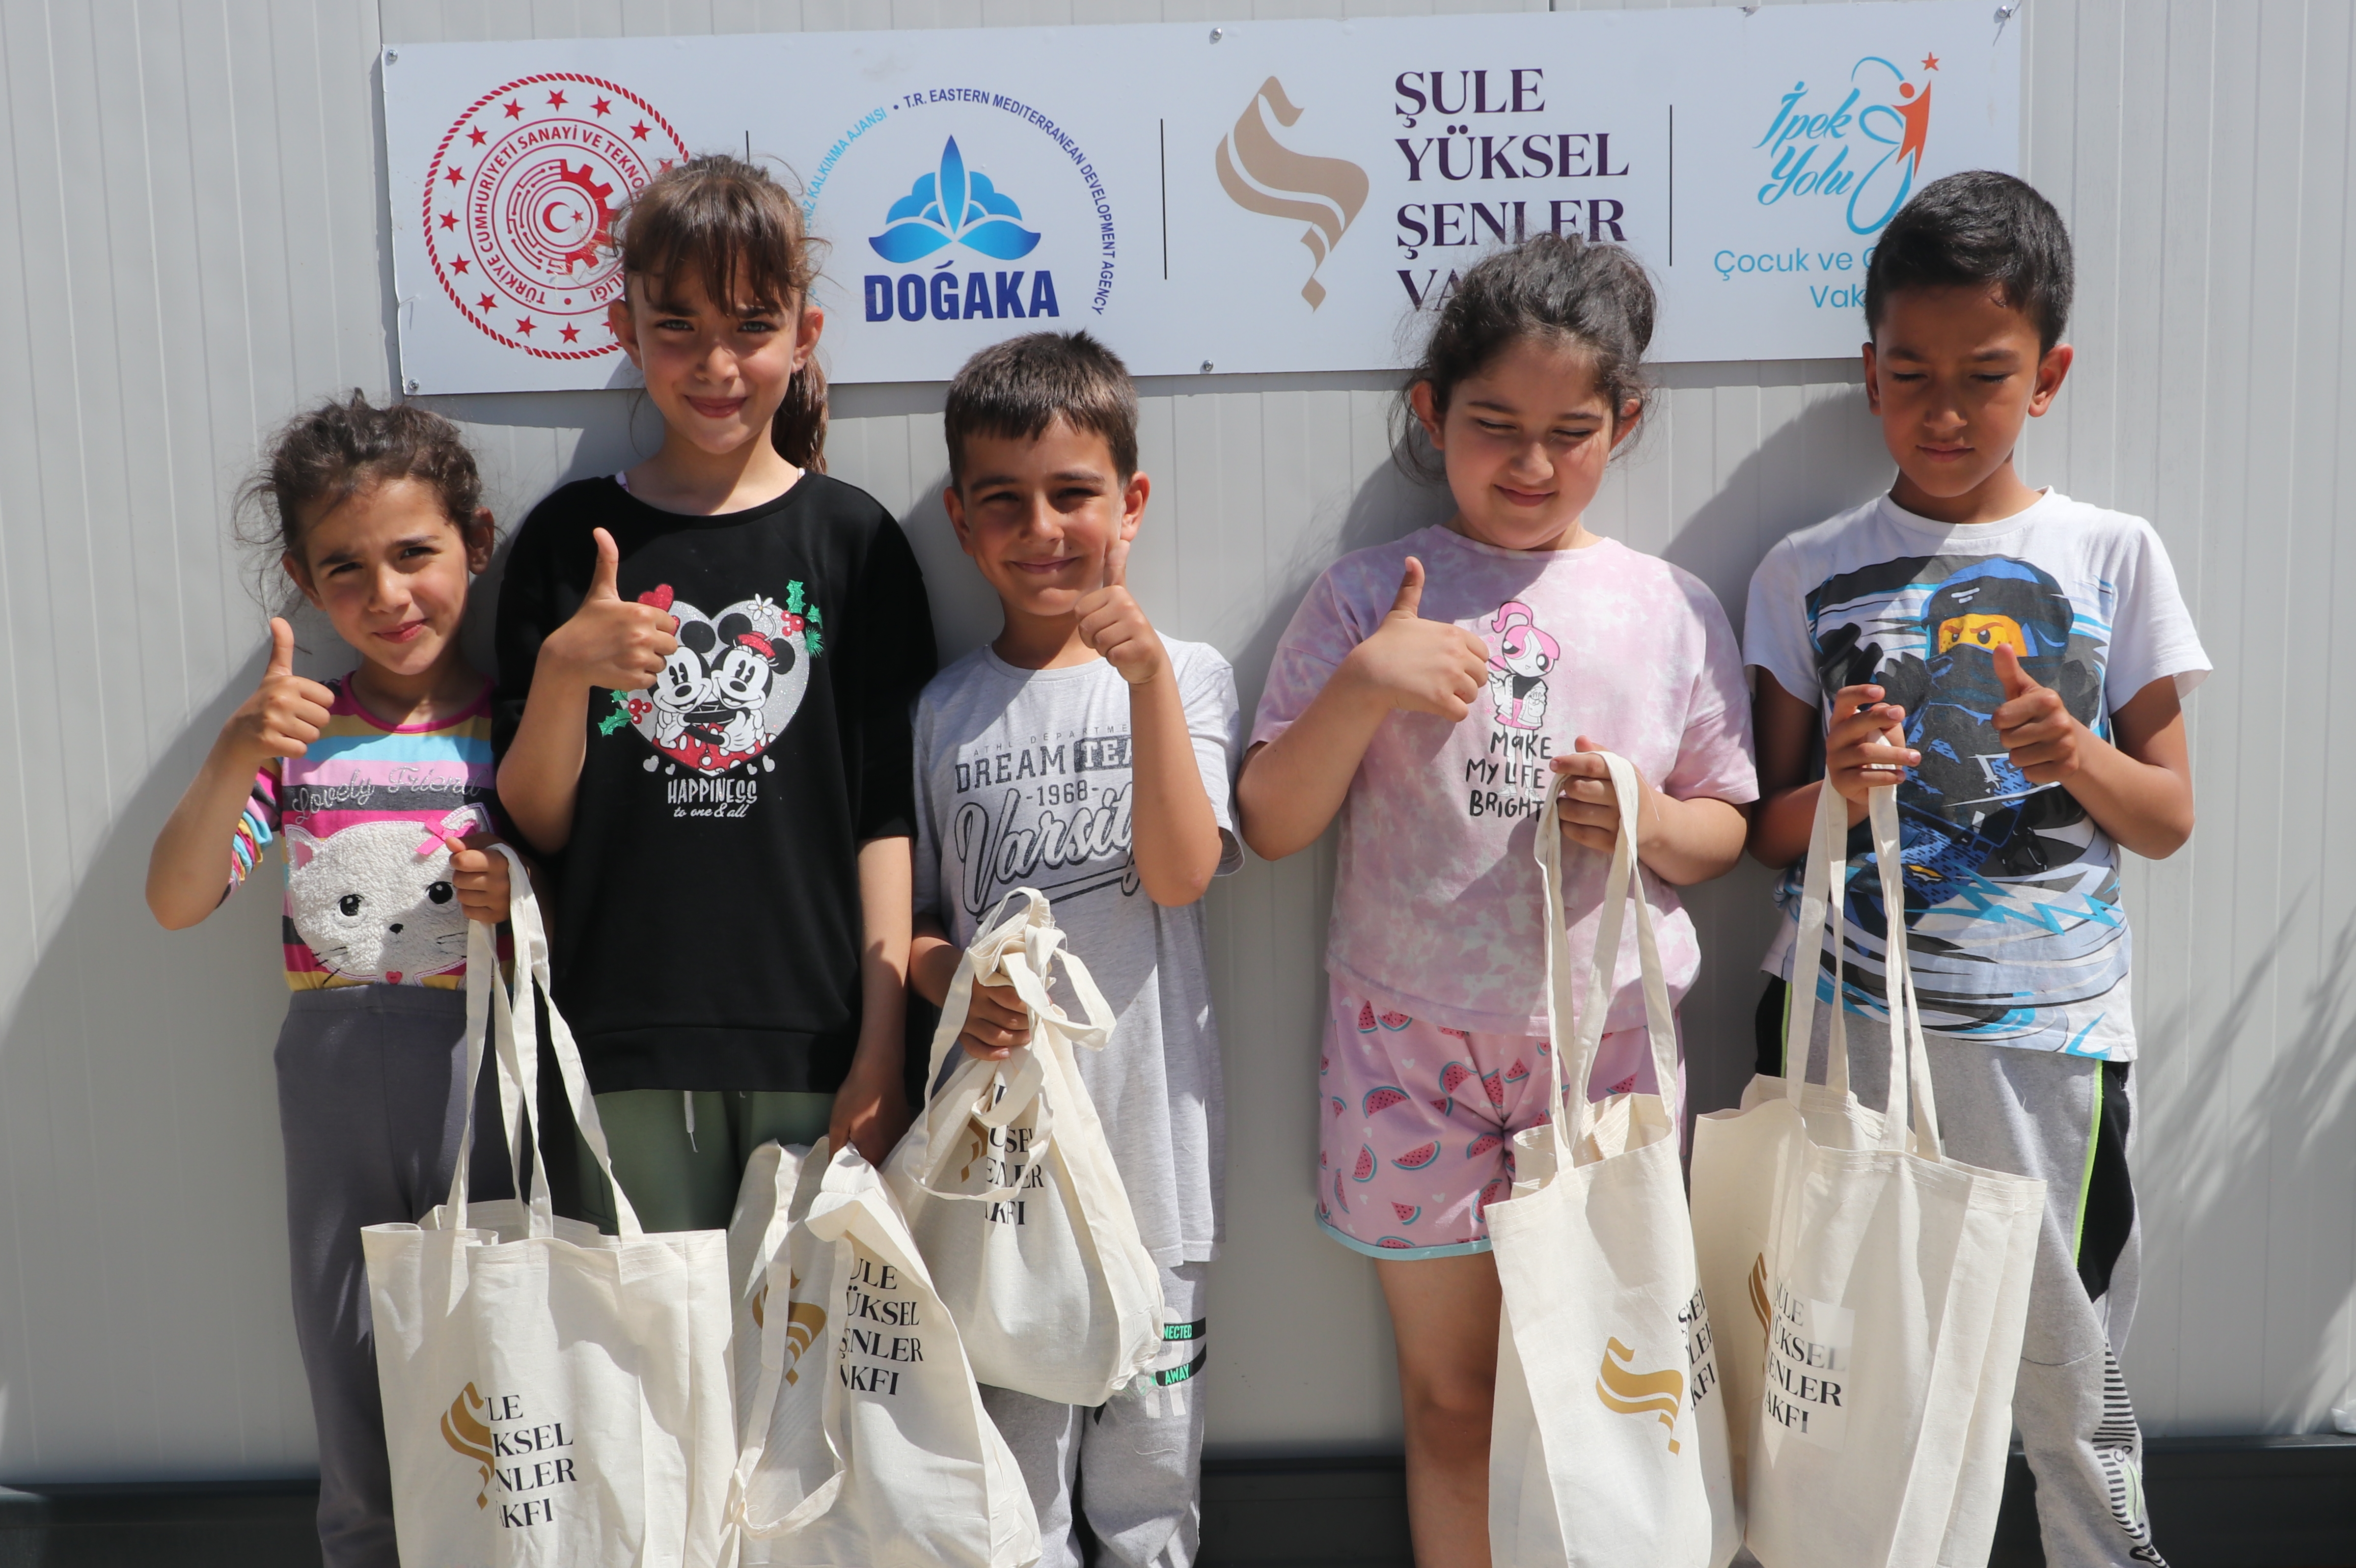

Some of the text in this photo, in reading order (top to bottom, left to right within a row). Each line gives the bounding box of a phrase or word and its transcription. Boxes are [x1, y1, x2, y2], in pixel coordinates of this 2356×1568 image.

[1395, 68, 1546, 129] ŞULE
[846, 107, 887, 142] AJANSI
[518, 125, 577, 148] SANAYİ
[582, 129, 602, 147] VE
[603, 141, 644, 191] TEKNO
[1395, 124, 1630, 181] YÜKSEL
[1757, 144, 1854, 205] Yolu
[903, 88, 1115, 316] T.R. EASTERN MEDITERRANEAN DEVELOPMENT AGENCY
[1714, 248, 1809, 280] Çocuk
[1818, 252, 1853, 271] ve
[864, 259, 1060, 322] DOĞAKA
[1810, 284, 1865, 307] Vak
[1030, 724, 1128, 743] DEPARTME
[955, 744, 1066, 794] DREAM
[292, 766, 488, 825] Lovely Friend
[667, 778, 758, 804] HAPPINESS
[1470, 790, 1544, 822] BRIGHT
[674, 802, 749, 818] to one & all
[847, 1285, 920, 1326] ÜKSEL
[1164, 1324, 1192, 1339] NECTED
[1165, 1364, 1189, 1385] AWAY
[491, 1423, 574, 1457] KSEL
[495, 1458, 577, 1492] NLER
[496, 1498, 553, 1528] KFI
